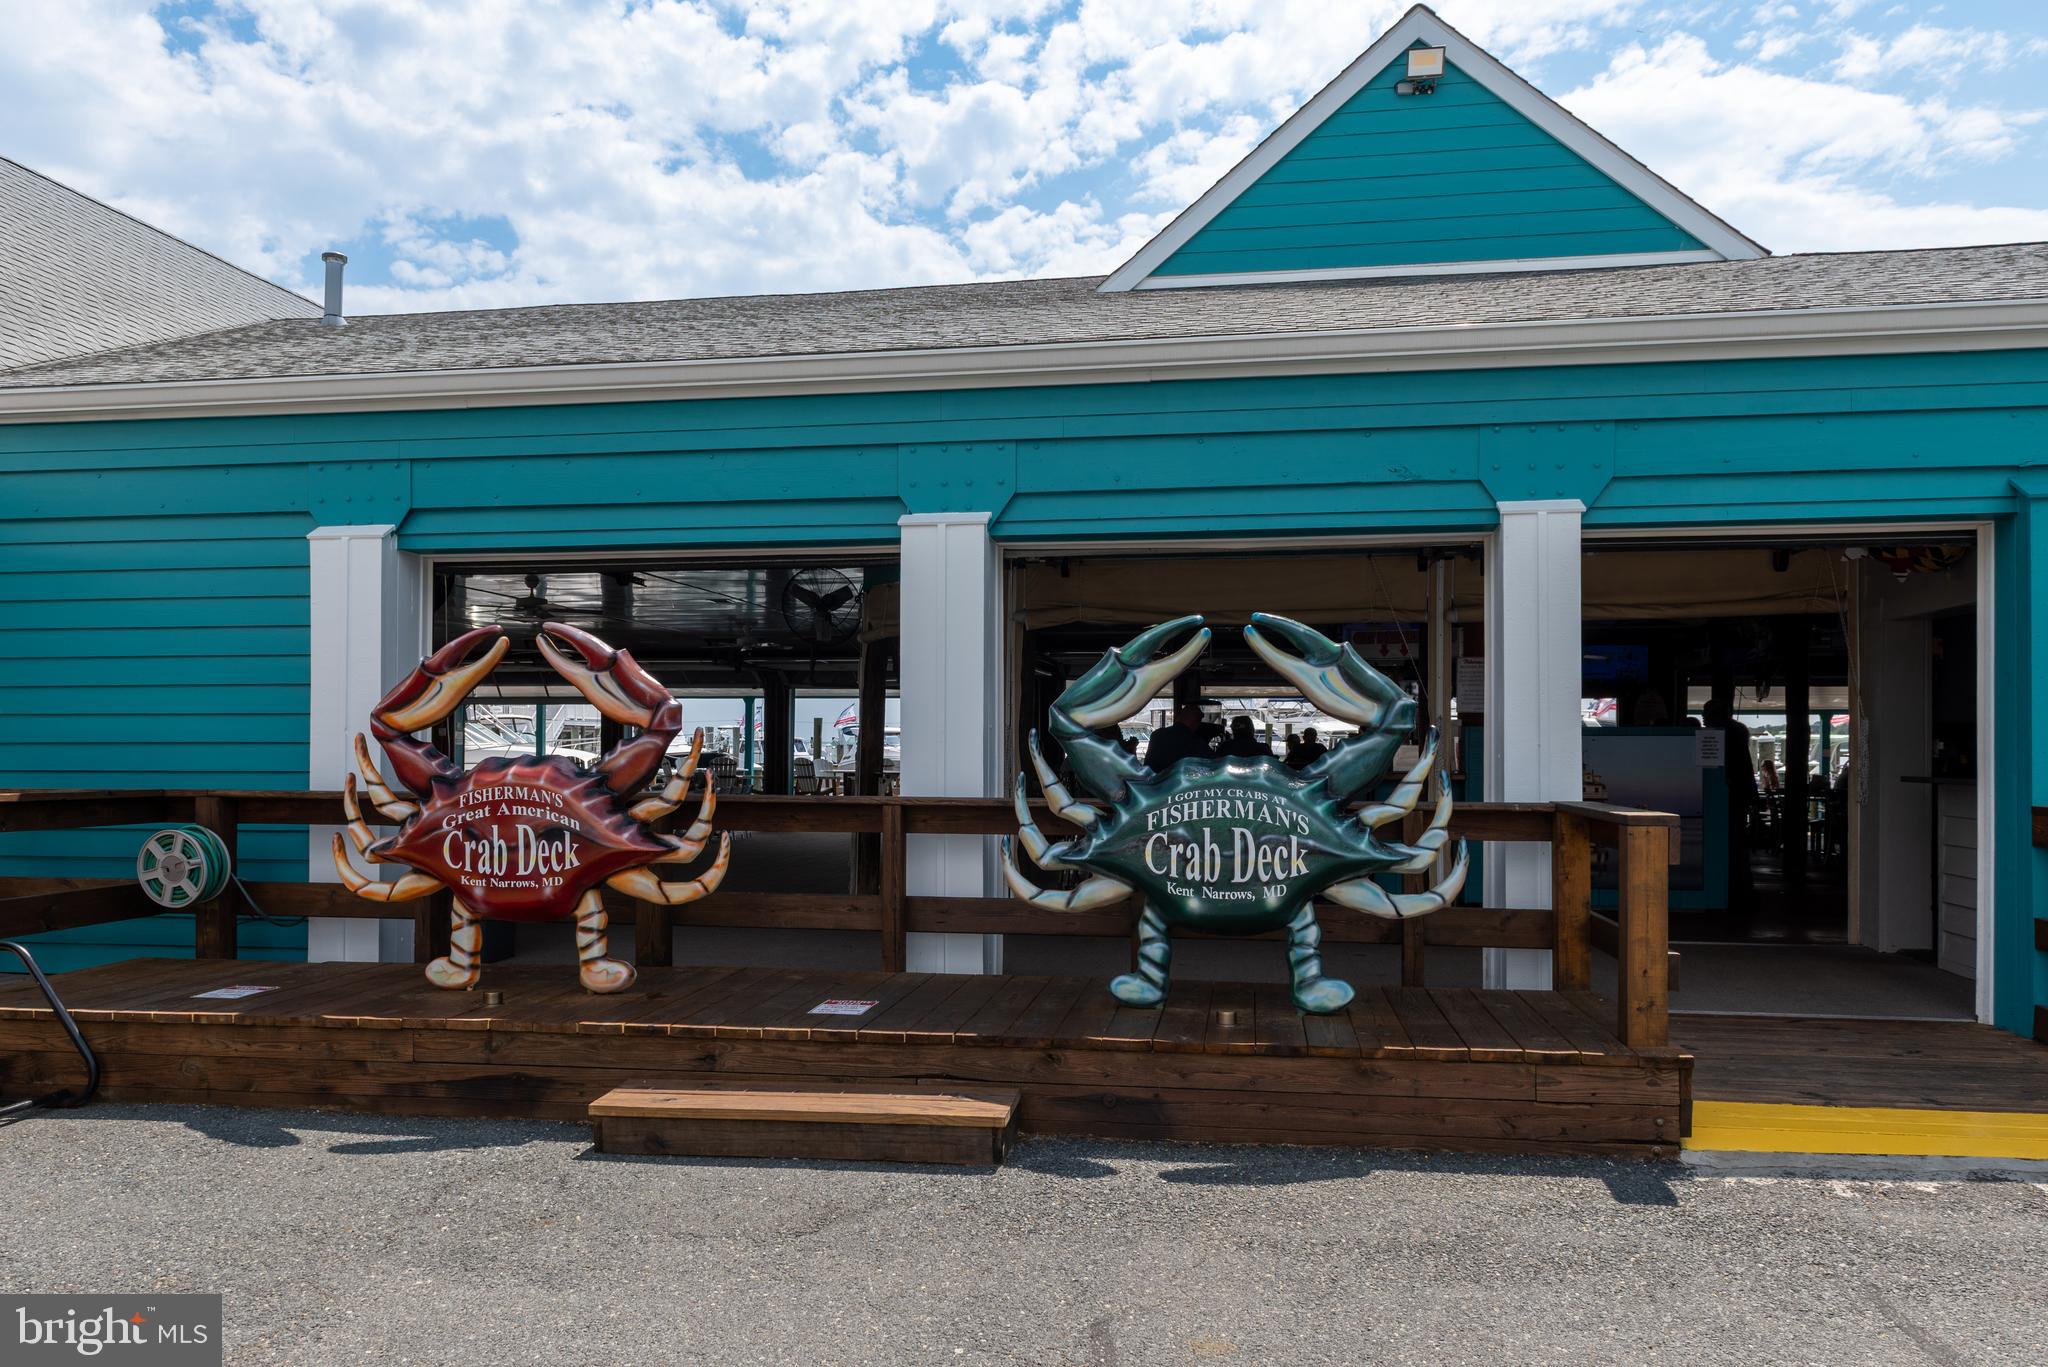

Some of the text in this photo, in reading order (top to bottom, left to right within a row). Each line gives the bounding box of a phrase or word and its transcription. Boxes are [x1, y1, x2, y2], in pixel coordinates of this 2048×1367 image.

[458, 786, 564, 809] FISHERMAN'S
[1168, 788, 1287, 806] I GOT MY CRABS AT
[442, 802, 581, 831] Great American
[1146, 799, 1310, 836] FISHERMAN'S
[443, 824, 581, 877] Crab Deck
[1145, 827, 1309, 884] Crab Deck
[461, 875, 563, 889] Kent Narrows, MD
[1166, 881, 1287, 902] Kent Narrows, MD
